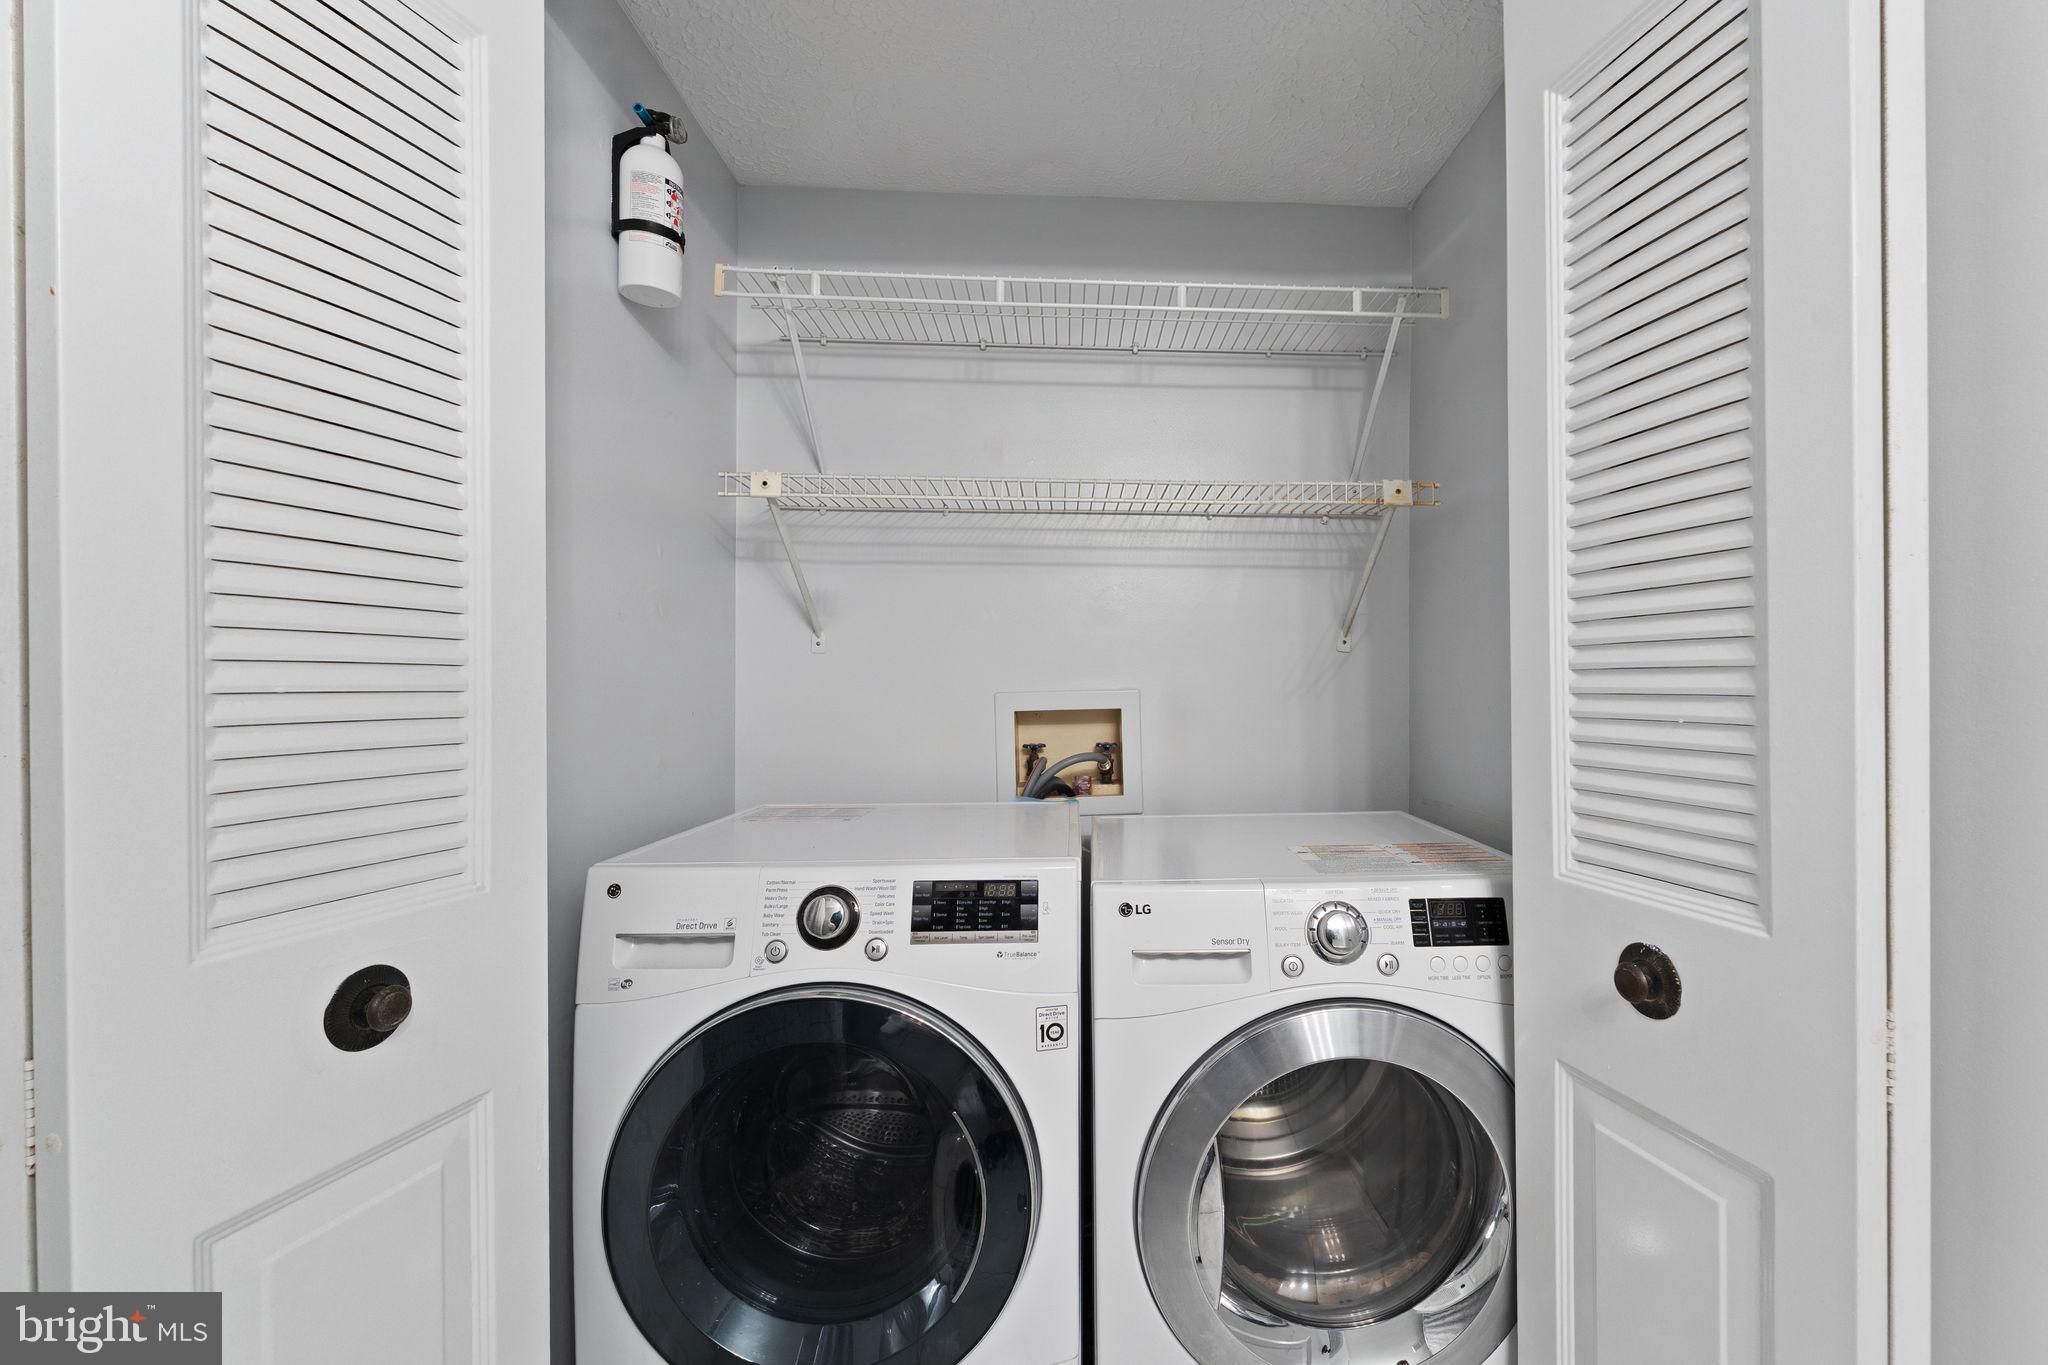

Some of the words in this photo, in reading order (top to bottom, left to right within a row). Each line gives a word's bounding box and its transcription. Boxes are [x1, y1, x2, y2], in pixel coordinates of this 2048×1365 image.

[1135, 904, 1151, 915] LG
[676, 922, 698, 930] Direct
[698, 921, 718, 930] Drive
[1211, 938, 1235, 946] Sensor
[1236, 938, 1250, 947] Dry
[1040, 1022, 1064, 1043] 10
